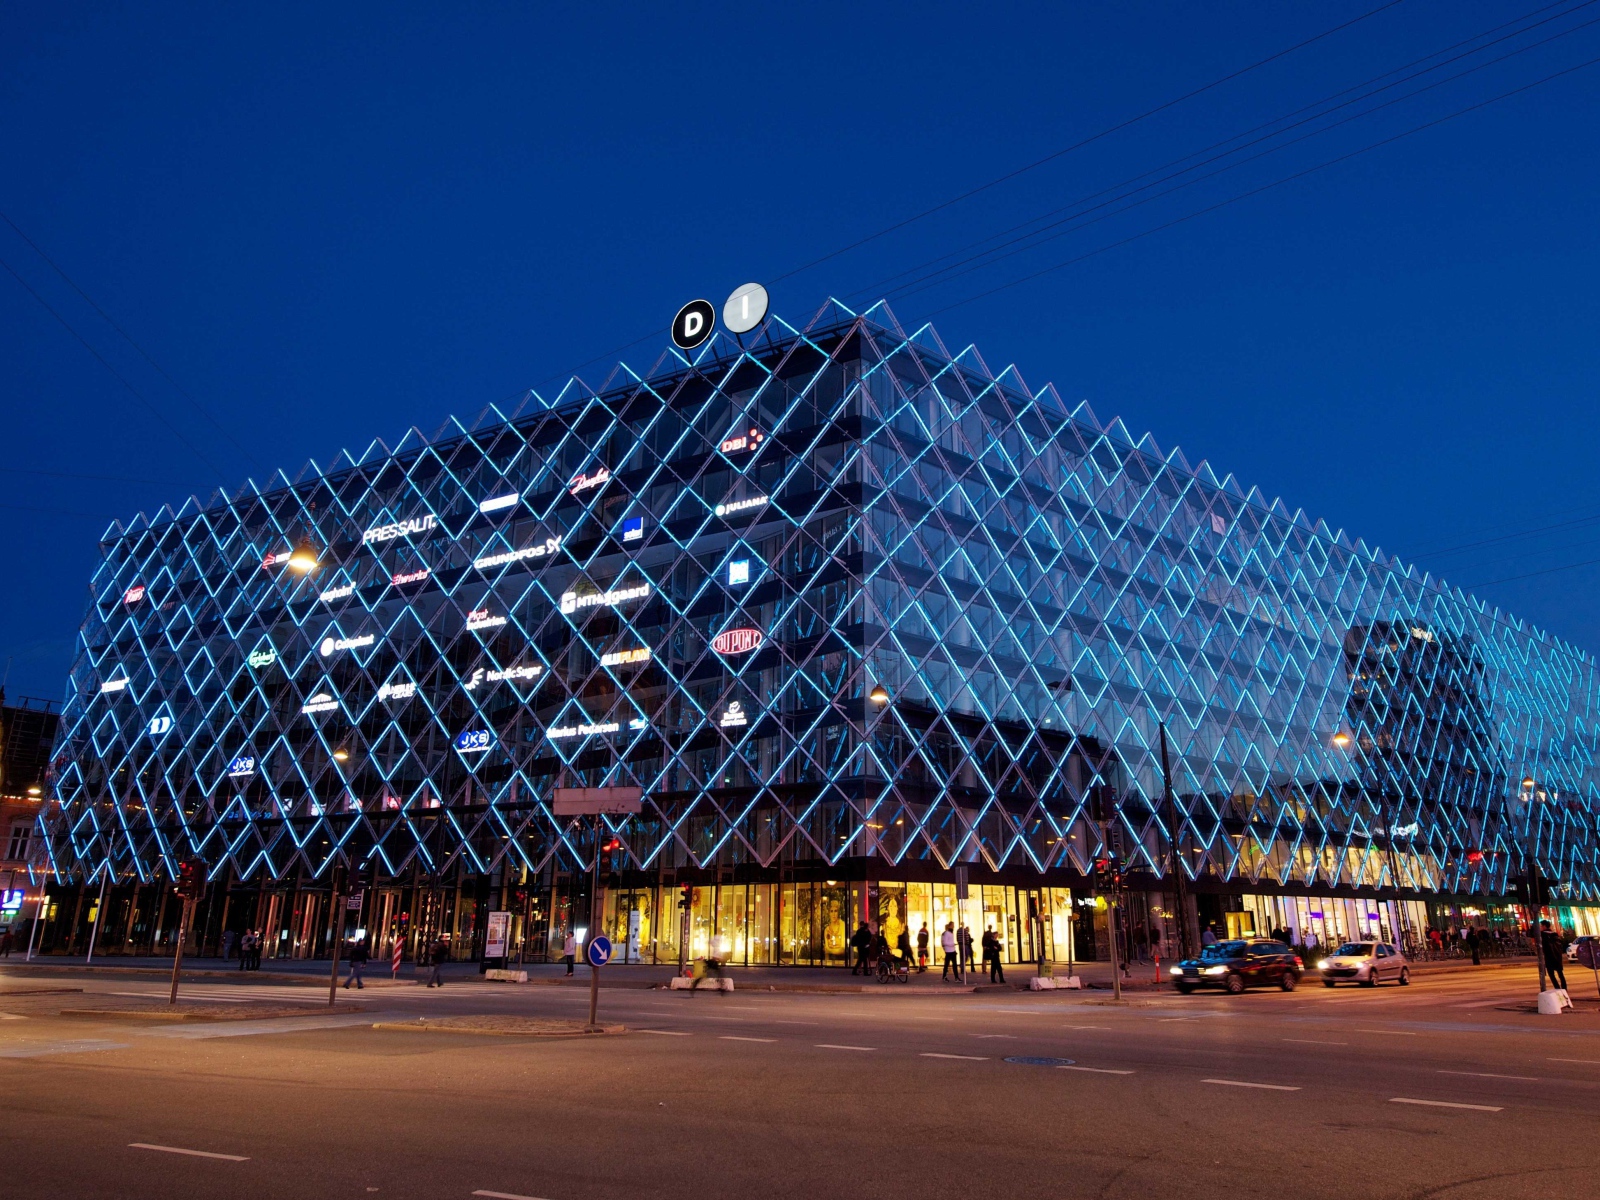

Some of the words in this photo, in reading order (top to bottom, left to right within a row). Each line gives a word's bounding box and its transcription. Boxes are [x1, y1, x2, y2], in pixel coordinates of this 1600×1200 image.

[684, 312, 704, 338] D
[721, 437, 747, 453] DBI
[474, 545, 546, 568] GRUNDFOS
